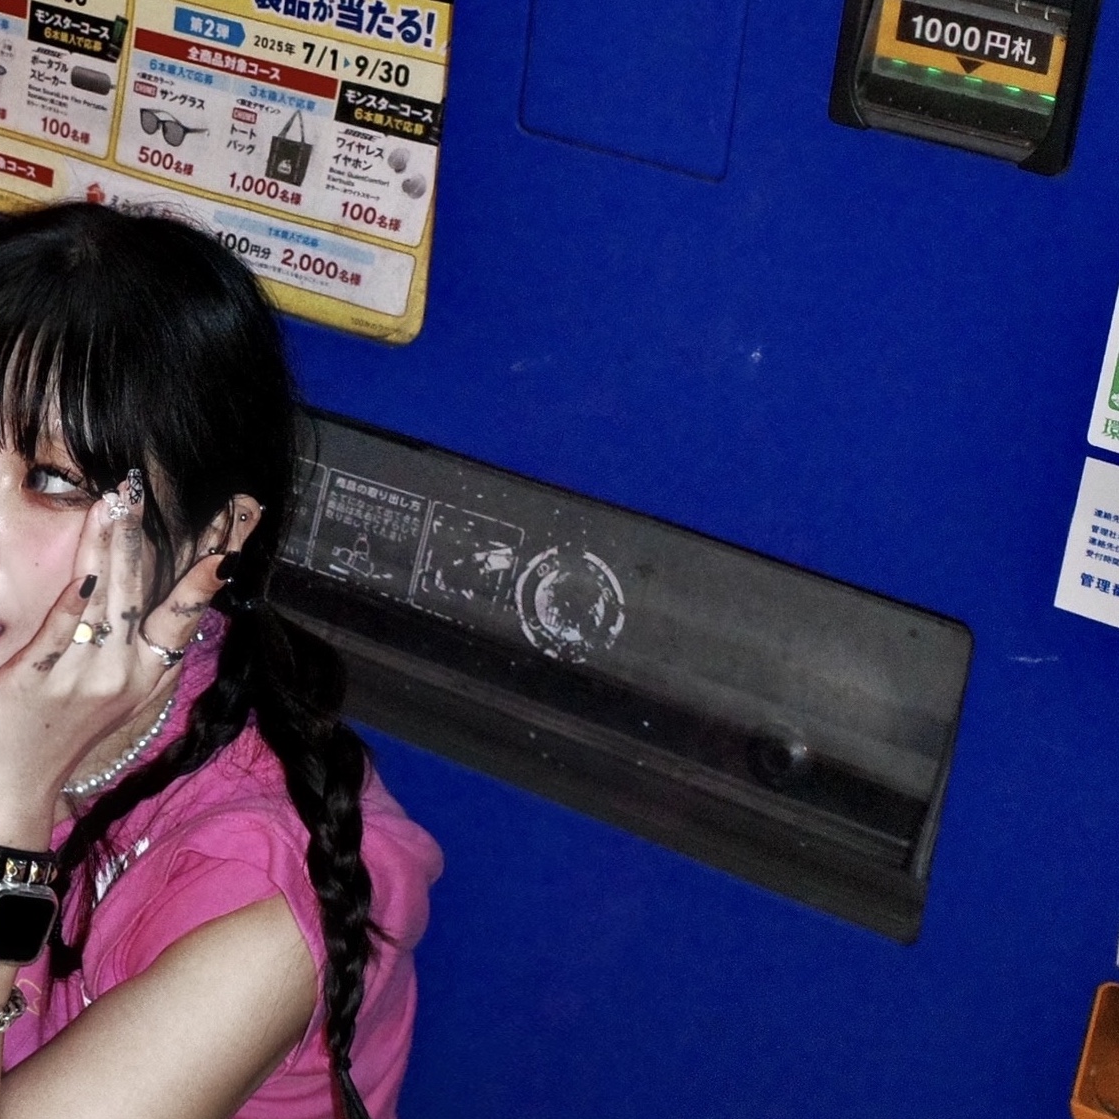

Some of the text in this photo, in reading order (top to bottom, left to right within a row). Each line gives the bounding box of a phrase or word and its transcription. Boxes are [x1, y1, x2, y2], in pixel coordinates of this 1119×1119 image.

[35, 9, 111, 40] モンスターコース
[44, 27, 102, 52] 6本購入で応募
[189, 16, 410, 87] 第2弾 2025年 7/1 9/30
[912, 14, 1036, 65] 1000円札
[149, 58, 214, 86] 6本購入で応募
[187, 46, 281, 81] 全商品対象コース
[159, 89, 205, 110] サングラス
[249, 85, 316, 111] 3本購入で応募
[345, 89, 433, 123] モンスターコース
[41, 117, 91, 144] 100名様
[230, 123, 257, 140] トート
[354, 108, 424, 135] 6本購入で応募
[138, 146, 194, 176] 500名様
[226, 140, 256, 155] バッグ
[332, 153, 373, 171] イヤホン
[336, 137, 385, 159] ワイヤレス
[229, 172, 302, 205] 1,000名様
[341, 200, 402, 232] 100名様
[281, 248, 362, 286] 2,000名様
[335, 477, 421, 511] 商品の取り出し方
